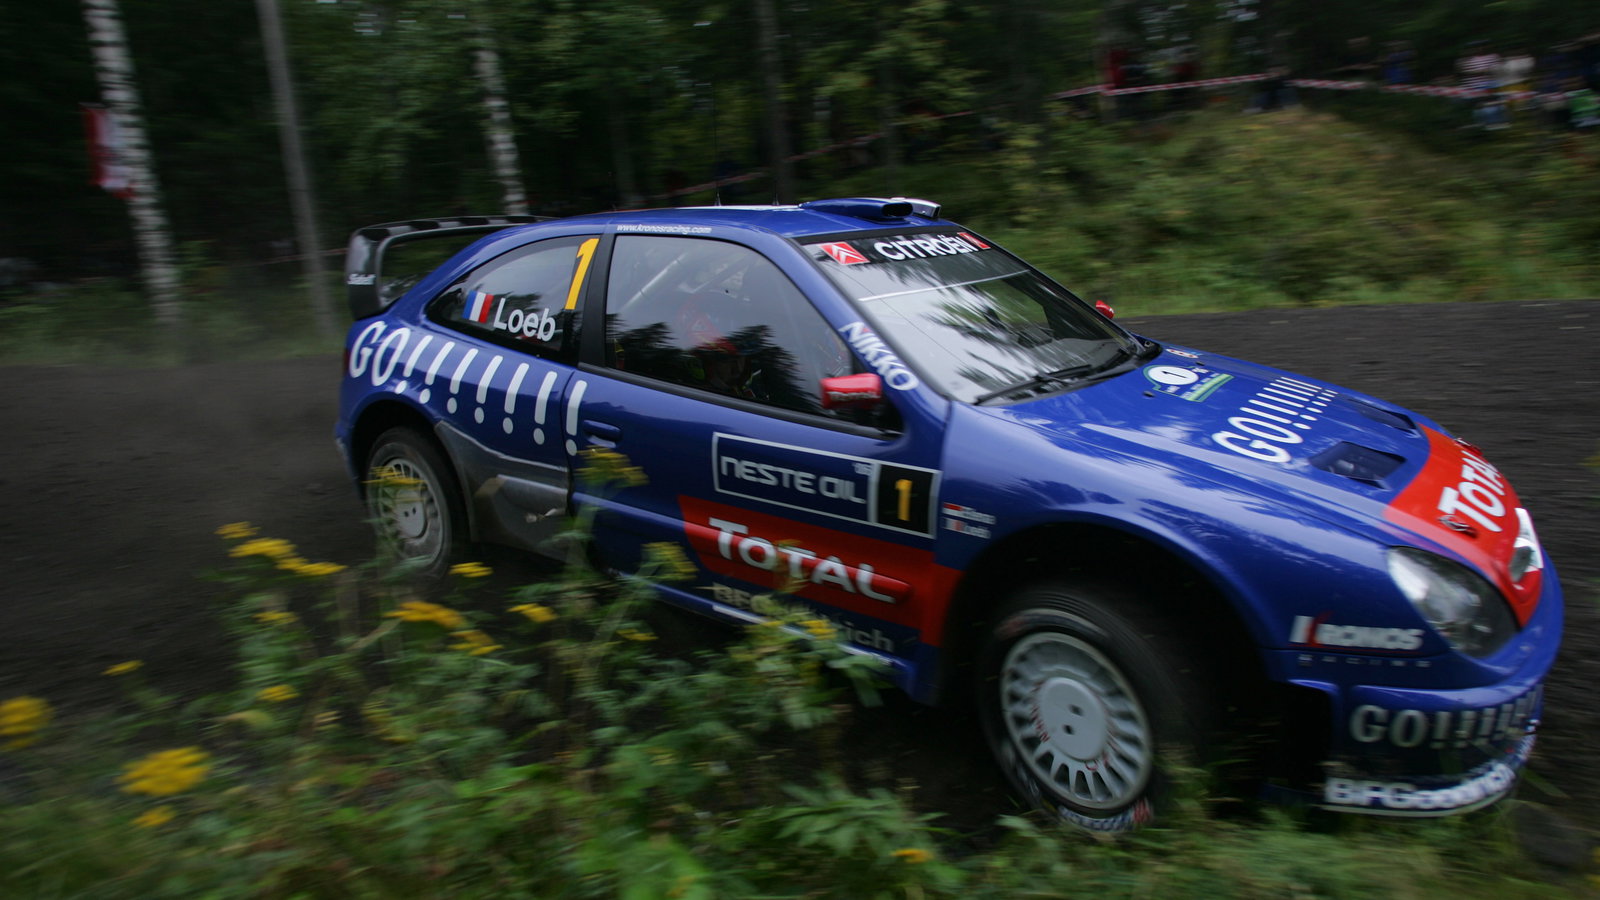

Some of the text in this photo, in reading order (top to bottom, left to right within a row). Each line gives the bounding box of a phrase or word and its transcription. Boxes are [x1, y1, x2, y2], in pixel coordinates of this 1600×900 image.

[874, 233, 978, 261] CITROËN
[565, 237, 599, 310] 1
[493, 297, 556, 343] Loeb
[839, 321, 919, 391] NIKKO
[819, 475, 866, 504] OIL
[895, 479, 913, 521] 1
[1437, 450, 1506, 533] TOTAL
